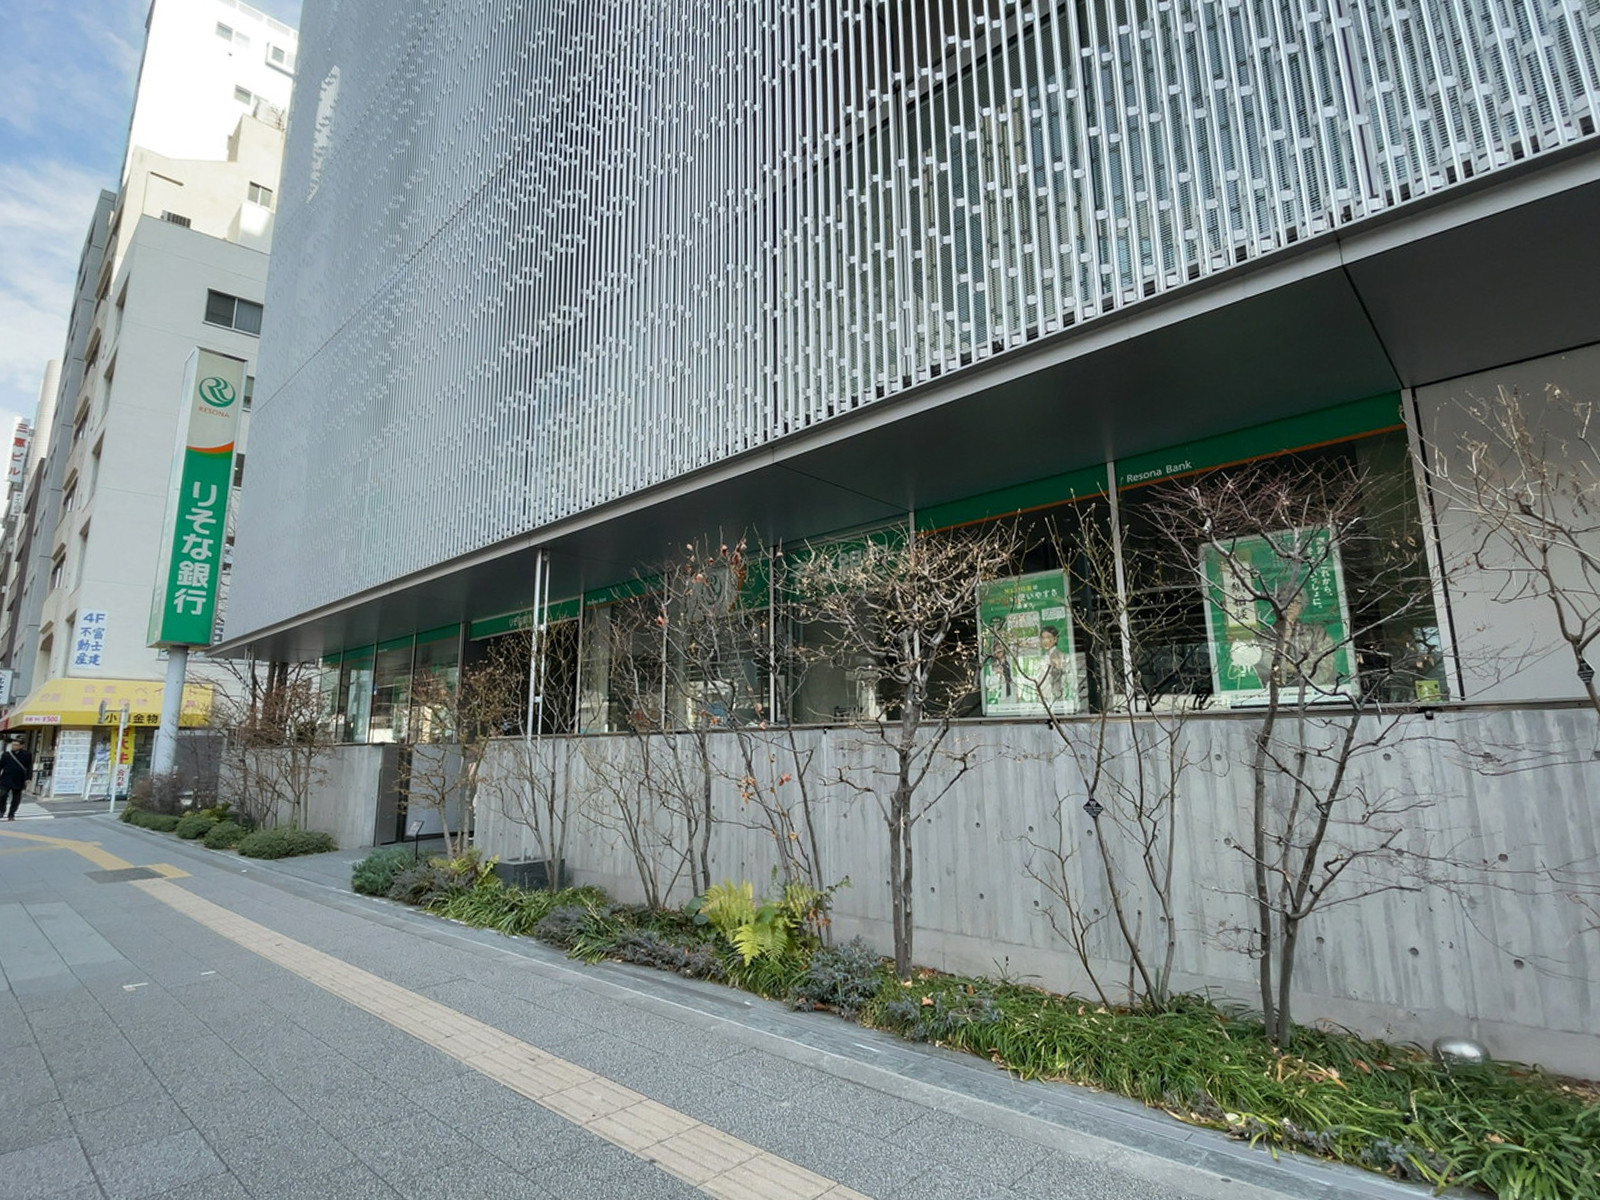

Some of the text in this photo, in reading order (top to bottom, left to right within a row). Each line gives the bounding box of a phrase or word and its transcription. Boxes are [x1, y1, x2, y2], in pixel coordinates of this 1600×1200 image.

[198, 406, 230, 418] RESONA
[1126, 460, 1193, 483] Resona Bank
[173, 481, 217, 616] りそな銀行
[83, 612, 106, 623] 4F
[74, 627, 92, 665] 不動産
[88, 627, 106, 666] 富士建
[105, 713, 159, 725] 小金物
